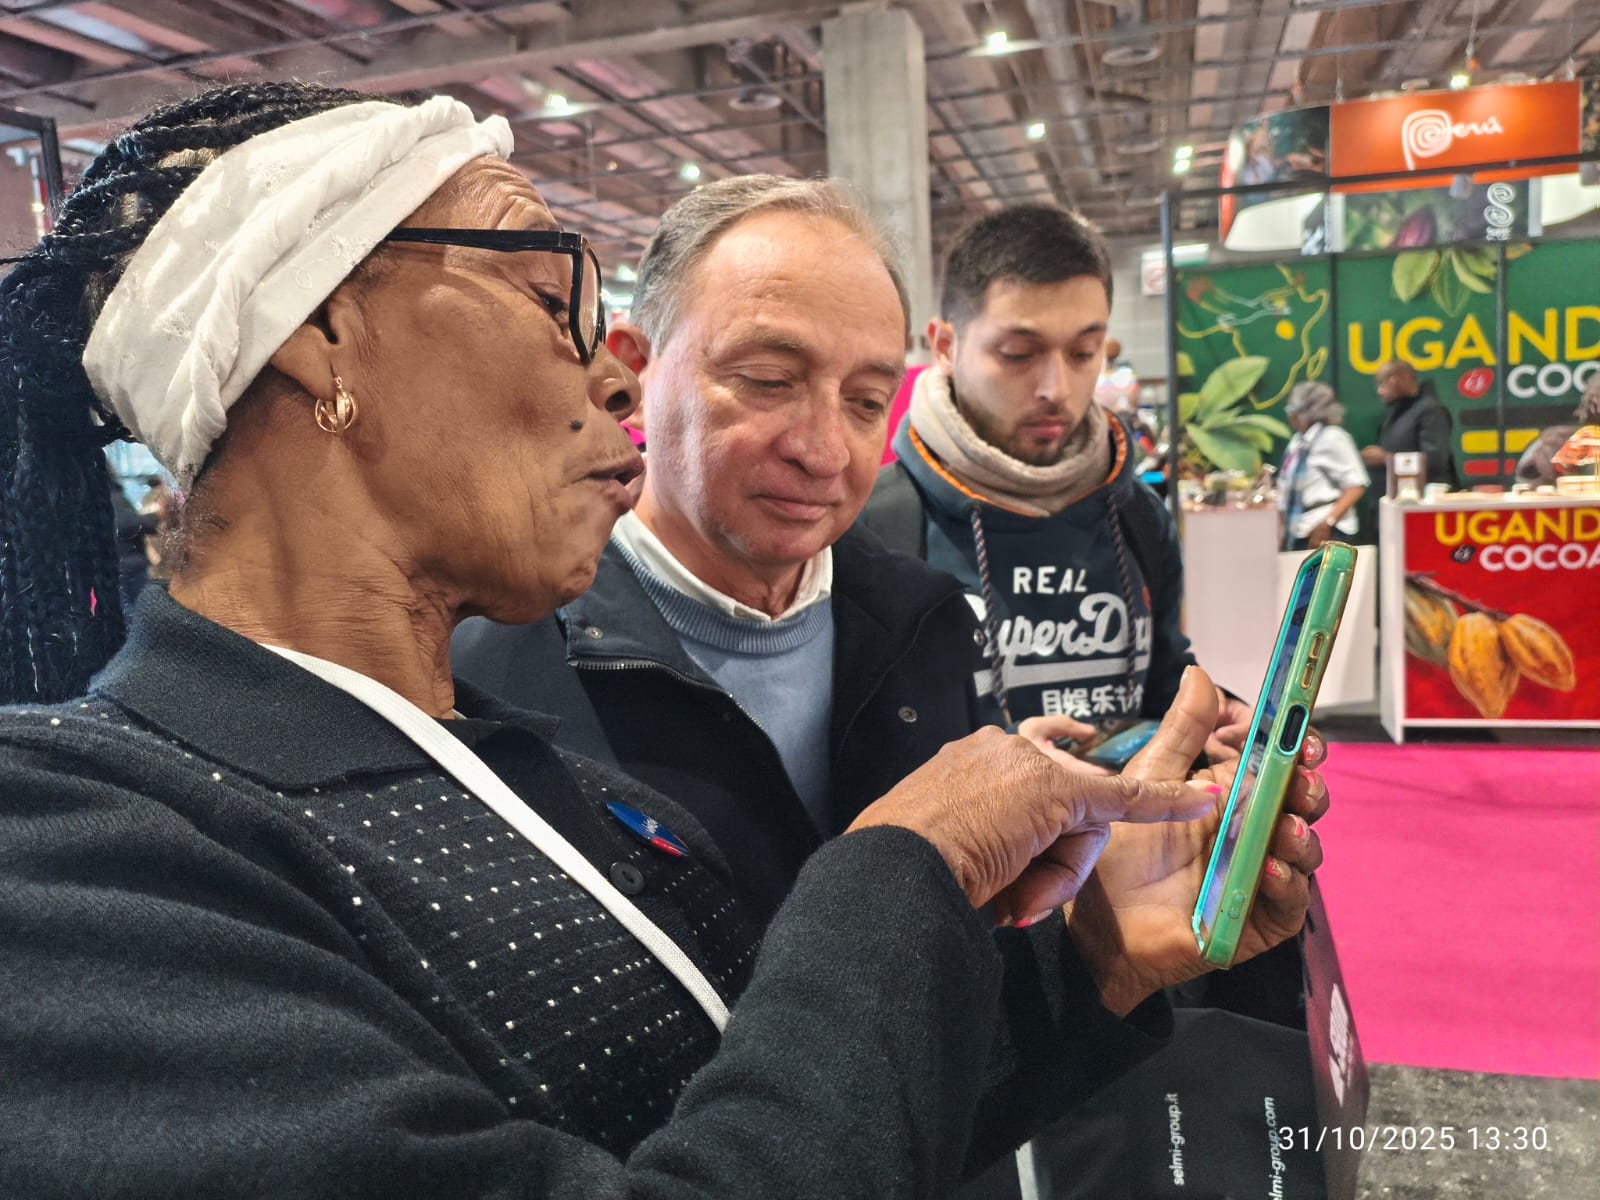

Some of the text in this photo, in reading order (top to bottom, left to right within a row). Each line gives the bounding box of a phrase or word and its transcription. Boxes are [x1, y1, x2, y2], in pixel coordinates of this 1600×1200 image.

[1348, 306, 1600, 375] UGAND
[1435, 508, 1600, 545] UGAND
[1013, 566, 1088, 594] REAL
[1165, 1092, 1185, 1186] selmi-group.it
